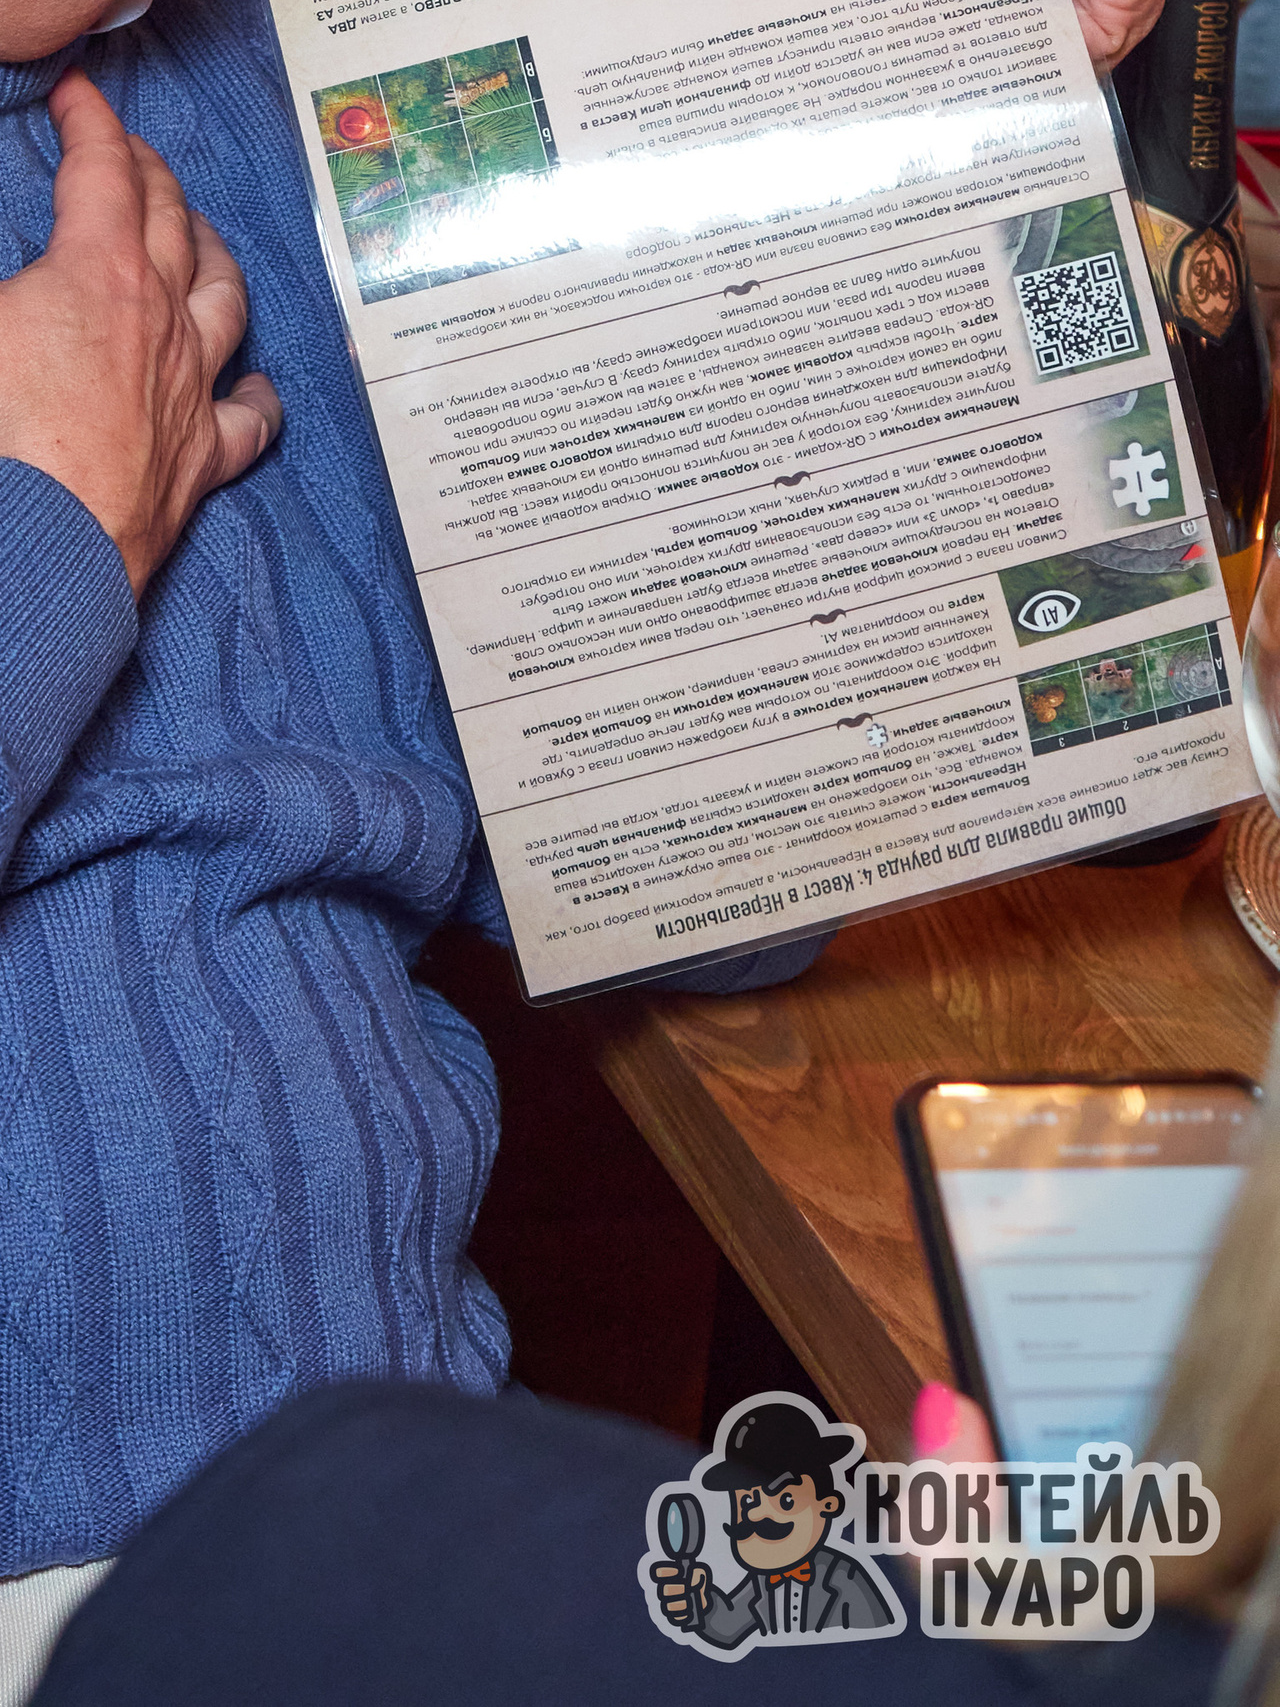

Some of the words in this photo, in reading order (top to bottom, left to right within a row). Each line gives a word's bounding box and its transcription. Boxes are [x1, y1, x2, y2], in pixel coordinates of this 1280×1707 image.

[856, 10, 889, 24] того,
[890, 1, 919, 15] путь
[830, 18, 853, 31] как
[786, 25, 828, 44] вашей
[728, 36, 783, 57] команде
[688, 51, 725, 68] найти
[525, 61, 535, 77] В
[611, 60, 685, 87] финальную
[573, 82, 608, 96] цель.
[542, 127, 553, 143] Б
[1005, 154, 1085, 180] информация,
[955, 175, 1003, 194] которая
[902, 189, 952, 208] поможет
[876, 202, 898, 214] при
[820, 207, 873, 229] решении
[753, 223, 817, 246] ключевых
[705, 250, 713, 258] и
[715, 240, 751, 256] задач
[920, 245, 981, 268] получите
[632, 253, 703, 277] нахождении
[885, 261, 917, 276] один
[553, 271, 629, 298] правильного
[832, 279, 847, 290] за
[850, 271, 882, 286] балл
[507, 292, 550, 310] пароля
[781, 284, 829, 303] верное
[497, 304, 505, 312] к
[716, 295, 778, 319] решение.
[440, 306, 495, 327] кодовым
[956, 312, 998, 328] карте.
[390, 321, 438, 339] замкам.
[912, 324, 955, 341] Чтобы
[855, 334, 910, 354] вскрыть
[793, 349, 853, 373] кодовый
[746, 365, 791, 382] замок,
[675, 383, 716, 401] нужно
[719, 377, 743, 390] вам
[636, 394, 672, 411] будет
[579, 405, 632, 425] перейти
[510, 425, 557, 443] ссылке
[560, 420, 576, 431] по
[483, 437, 507, 450] при
[428, 444, 480, 464] помощи
[983, 495, 999, 505] 1»,
[1001, 481, 1054, 501] «вправо
[922, 511, 937, 522] 3»
[940, 501, 980, 517] «down
[895, 515, 919, 528] или
[1012, 512, 1063, 531] задачи.
[811, 533, 843, 548] два».
[847, 524, 892, 540] «север
[991, 526, 1010, 538] На
[940, 531, 988, 553] первой
[750, 544, 809, 566] Решение
[870, 544, 938, 571] ключевой
[679, 560, 747, 586] ключевой
[821, 563, 868, 582] задаче
[629, 578, 677, 596] задачи
[774, 576, 818, 594] всегда
[587, 590, 627, 608] может
[680, 588, 771, 618] зашифровано
[947, 592, 985, 609] карте
[552, 602, 584, 615] быть
[928, 603, 944, 614] по
[1041, 605, 1060, 627] А1
[618, 621, 642, 634] или
[645, 612, 677, 627] одно
[841, 608, 925, 637] координатам
[547, 628, 615, 652] несколько
[820, 631, 837, 644] А1.
[927, 624, 992, 648] находится
[510, 646, 544, 661] слов.
[844, 642, 924, 670] содержимое
[982, 655, 1001, 667] На
[811, 664, 841, 680] этой
[931, 661, 980, 682] каждой
[1215, 656, 1224, 670] А
[736, 672, 809, 700] маленькой
[855, 674, 928, 703] маленькой
[672, 692, 734, 715] карточки
[793, 695, 853, 717] карточке
[942, 699, 1011, 724] ключевые
[654, 708, 670, 719] на
[751, 711, 779, 728] углу
[781, 711, 790, 720] в
[591, 714, 651, 738] большой
[889, 718, 939, 737] задачи.
[1123, 720, 1130, 731] 2
[548, 729, 589, 746] карте.
[676, 722, 748, 748] изображен
[978, 729, 1018, 746] карте.
[1059, 737, 1066, 748] 3
[1160, 730, 1225, 755] проходить
[626, 742, 674, 761] символ
[914, 753, 930, 764] на
[932, 742, 976, 758] Также,
[1133, 751, 1158, 763] его.
[1190, 746, 1228, 764] Снизу
[577, 765, 585, 773] с
[587, 755, 623, 770] глаза
[852, 759, 912, 783] большой
[1165, 758, 1187, 771] вас
[528, 767, 574, 788] буквой
[1132, 765, 1163, 781] ждет
[517, 780, 526, 788] и
[812, 775, 849, 792] карте
[1069, 775, 1128, 799] описание
[745, 786, 810, 810] находится
[1036, 793, 1066, 809] всех
[689, 804, 742, 824] скрытая
[958, 803, 1033, 830] материалов
[1066, 796, 1126, 825] Общие
[611, 817, 686, 845] финальная
[932, 823, 955, 837] для
[984, 813, 1063, 848] правила
[576, 839, 608, 853] цель
[874, 844, 882, 853] в
[885, 832, 929, 850] Квеста
[946, 834, 980, 860] для
[525, 846, 574, 866] раунда,
[776, 847, 871, 879] НЕреальности,
[876, 843, 943, 878] раунда
[766, 874, 774, 883] а
[856, 867, 872, 885] 4:
[715, 875, 763, 897] дальше
[787, 887, 799, 903] в
[803, 872, 854, 900] Квест
[652, 891, 712, 915] короткий
[603, 905, 650, 926] разбор
[654, 891, 784, 939] НЕреальности
[544, 929, 567, 941] как
[569, 920, 601, 934] того,
